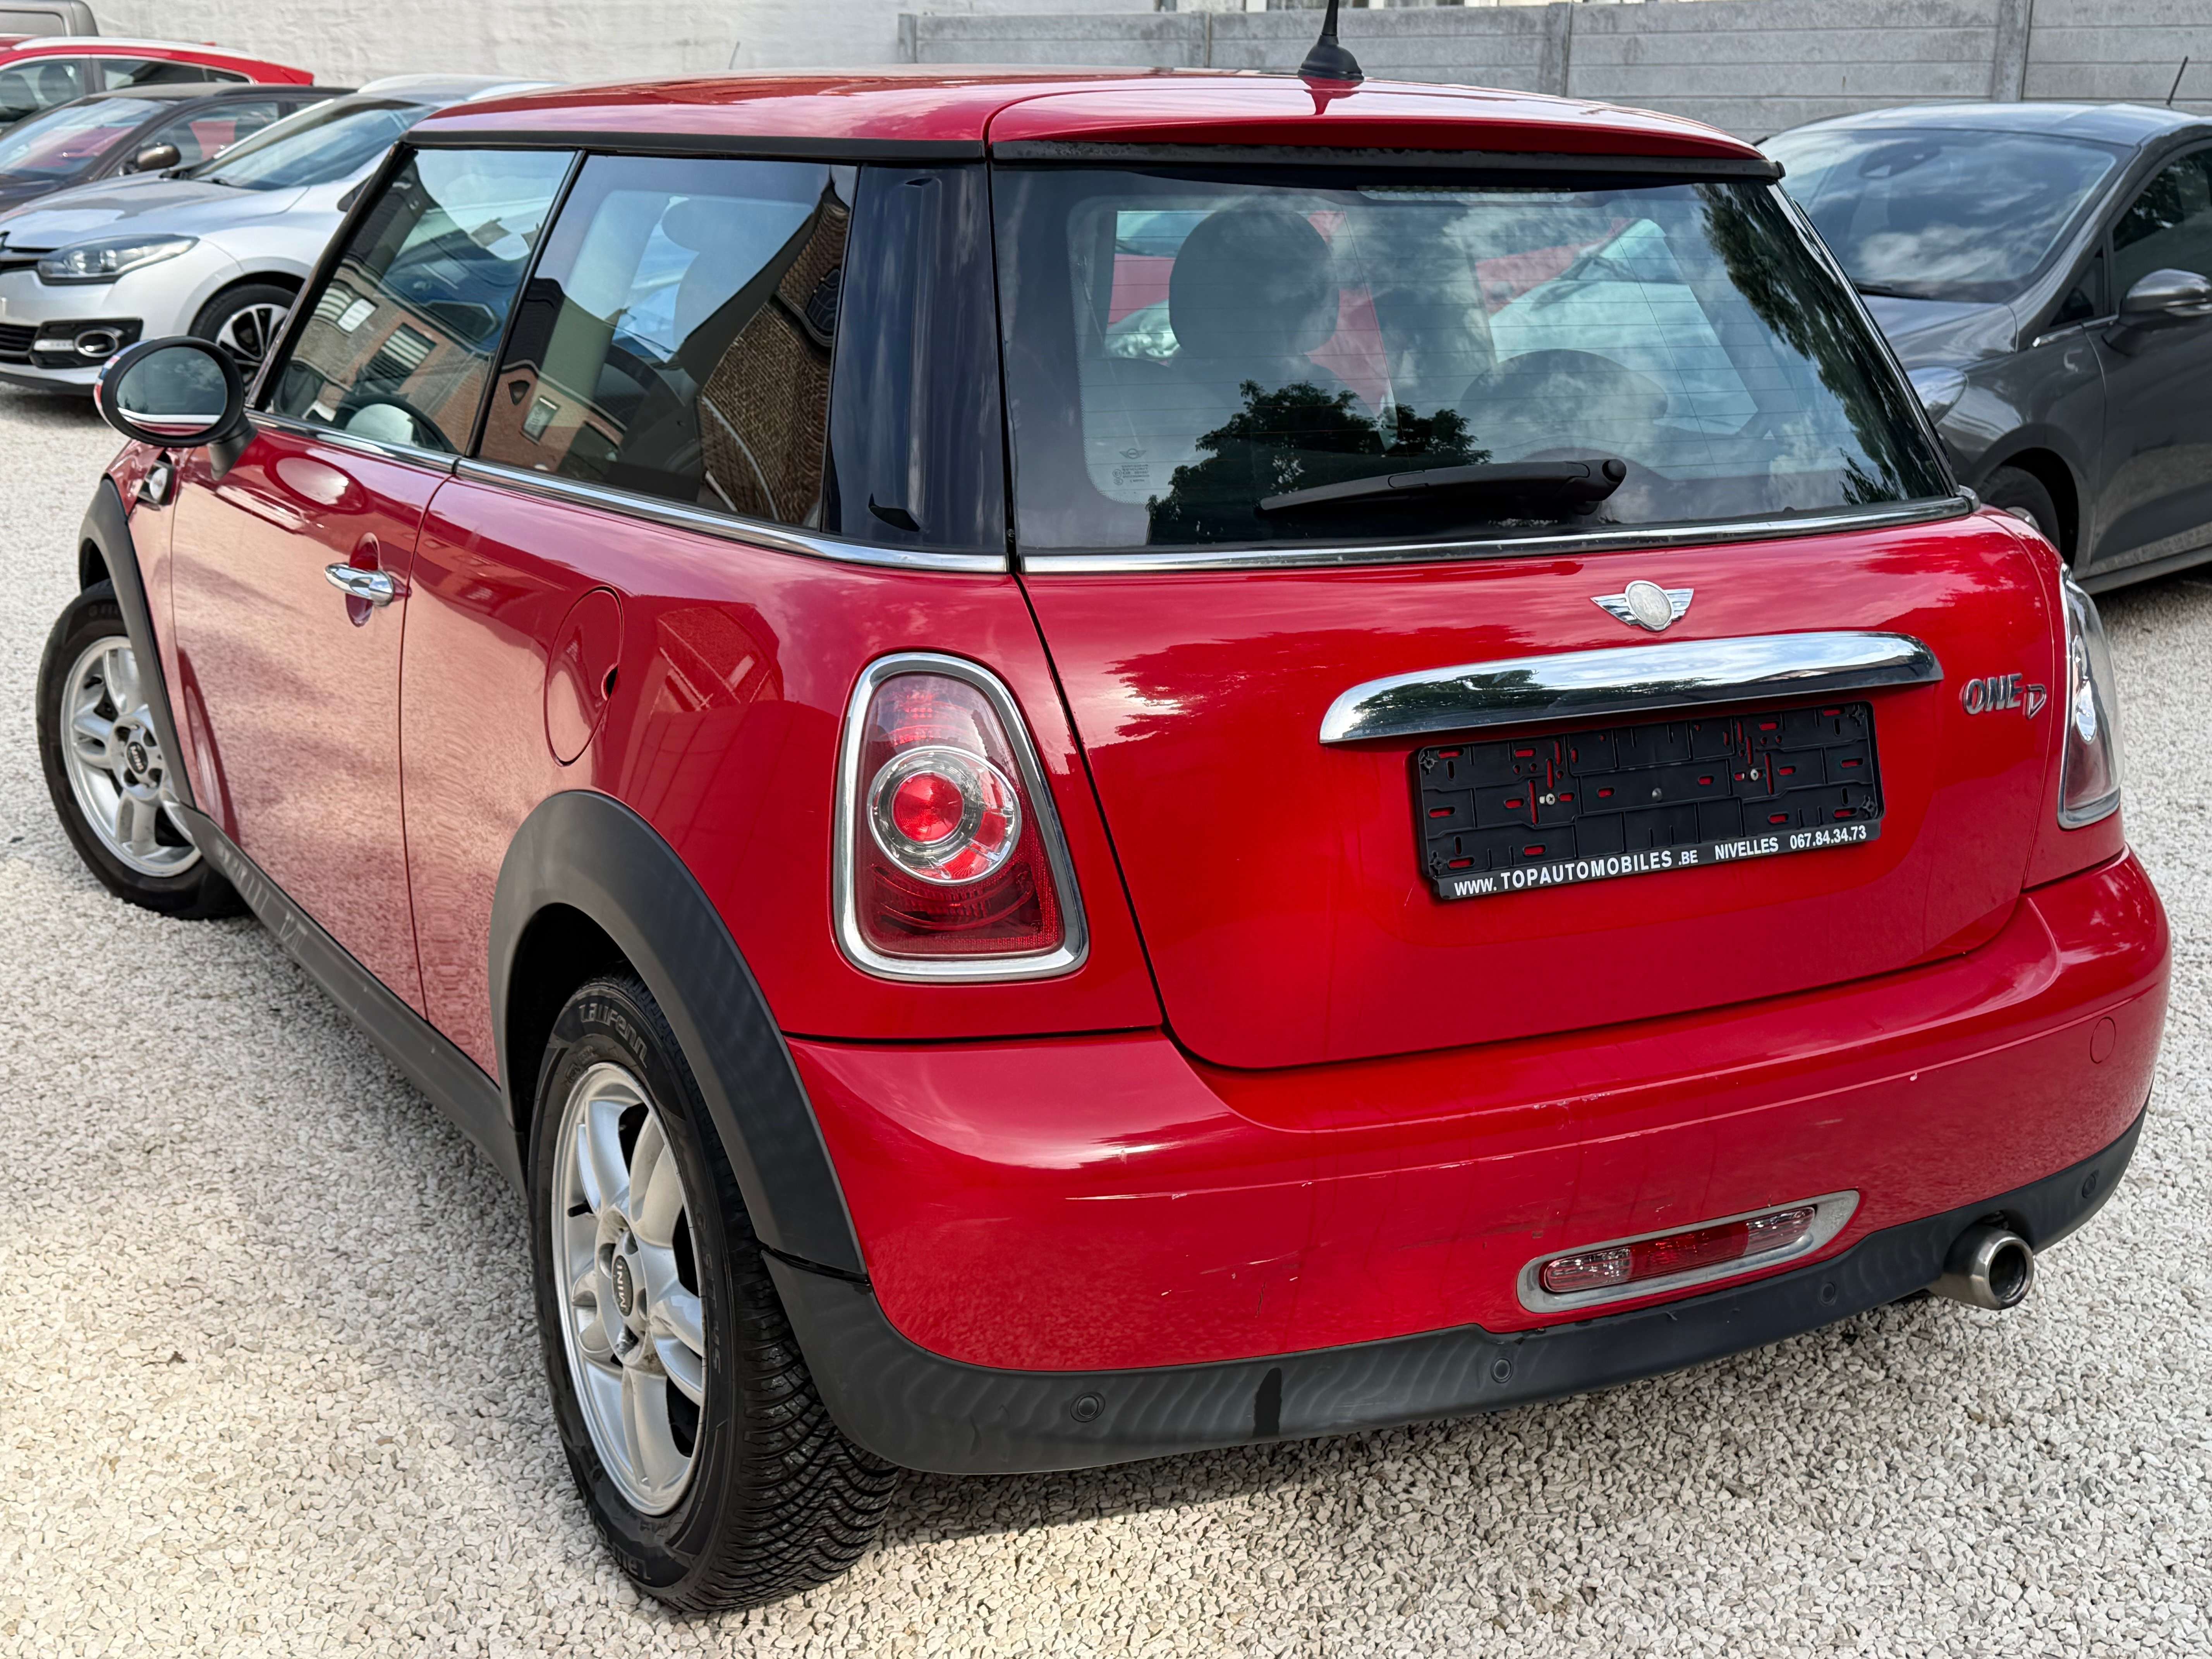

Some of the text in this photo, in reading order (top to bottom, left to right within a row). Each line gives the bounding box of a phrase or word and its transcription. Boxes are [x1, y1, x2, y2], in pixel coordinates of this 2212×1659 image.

[1963, 673, 2047, 720] ONE D
[1715, 837, 1779, 860] NIVELLES
[1790, 825, 1867, 849] 067.84.34.73
[617, 1264, 627, 1308] MINI
